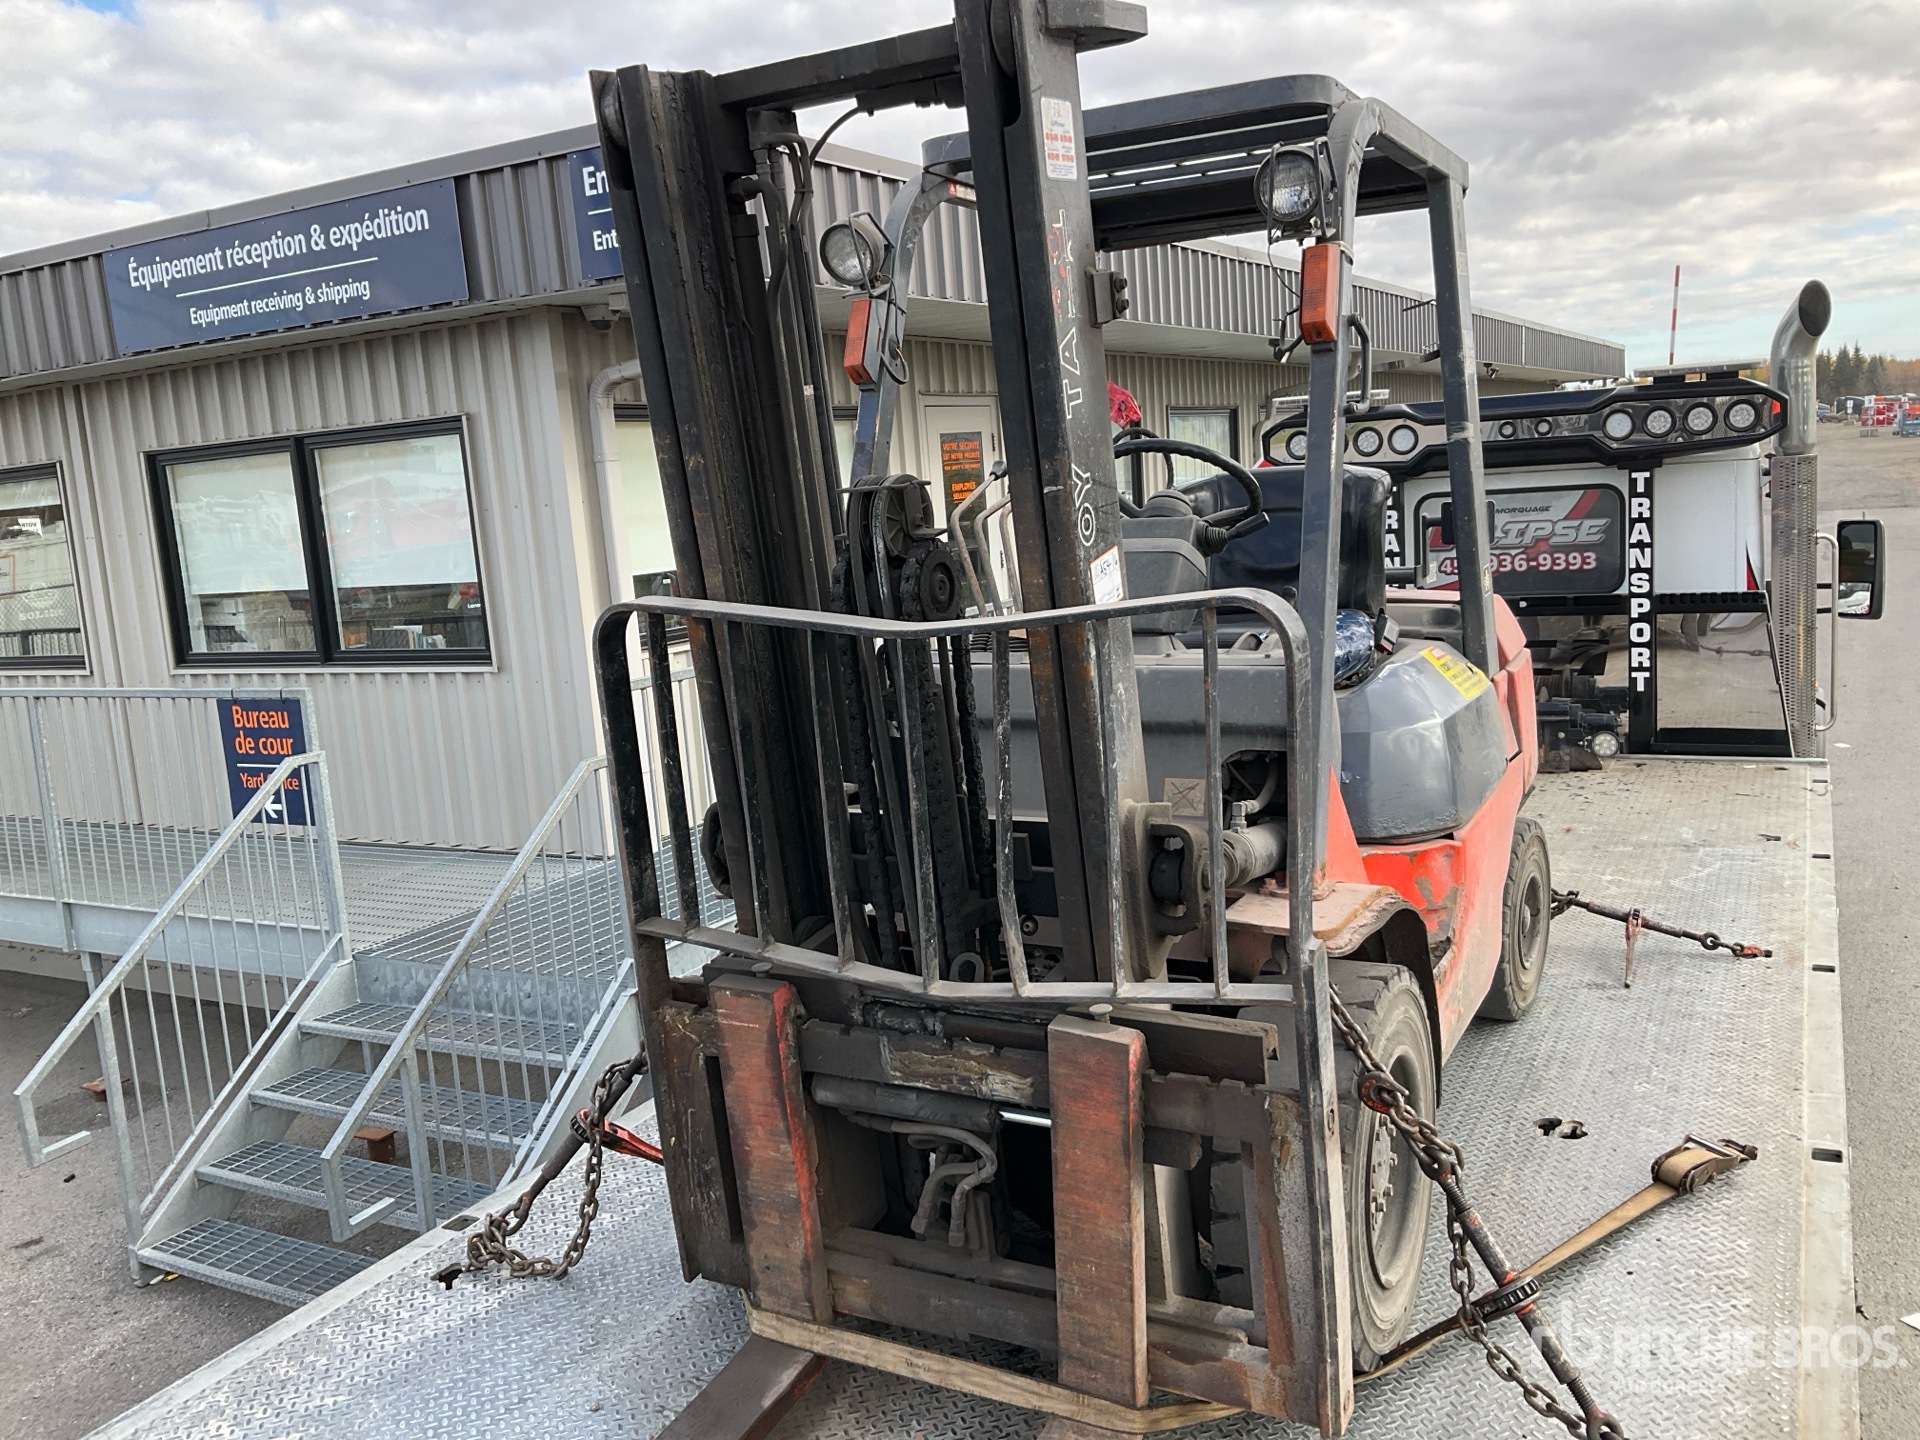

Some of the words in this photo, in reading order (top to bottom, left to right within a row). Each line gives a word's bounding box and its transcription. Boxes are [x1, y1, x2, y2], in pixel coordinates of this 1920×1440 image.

[582, 166, 609, 196] En
[128, 247, 224, 291] Équipement
[226, 230, 307, 269] réception
[310, 224, 326, 251] &
[329, 206, 430, 251] expédition
[593, 229, 619, 251] Ent
[189, 299, 250, 328] Equipment
[251, 290, 304, 311] receiving
[305, 286, 315, 305] &
[317, 278, 371, 305] shipping
[1495, 505, 1552, 514] MORQUAGE
[1629, 471, 1652, 692] TRANSPORT
[231, 705, 290, 729] Bureau
[235, 730, 256, 754] de
[259, 737, 294, 755] cour
[240, 772, 264, 789] Yard
